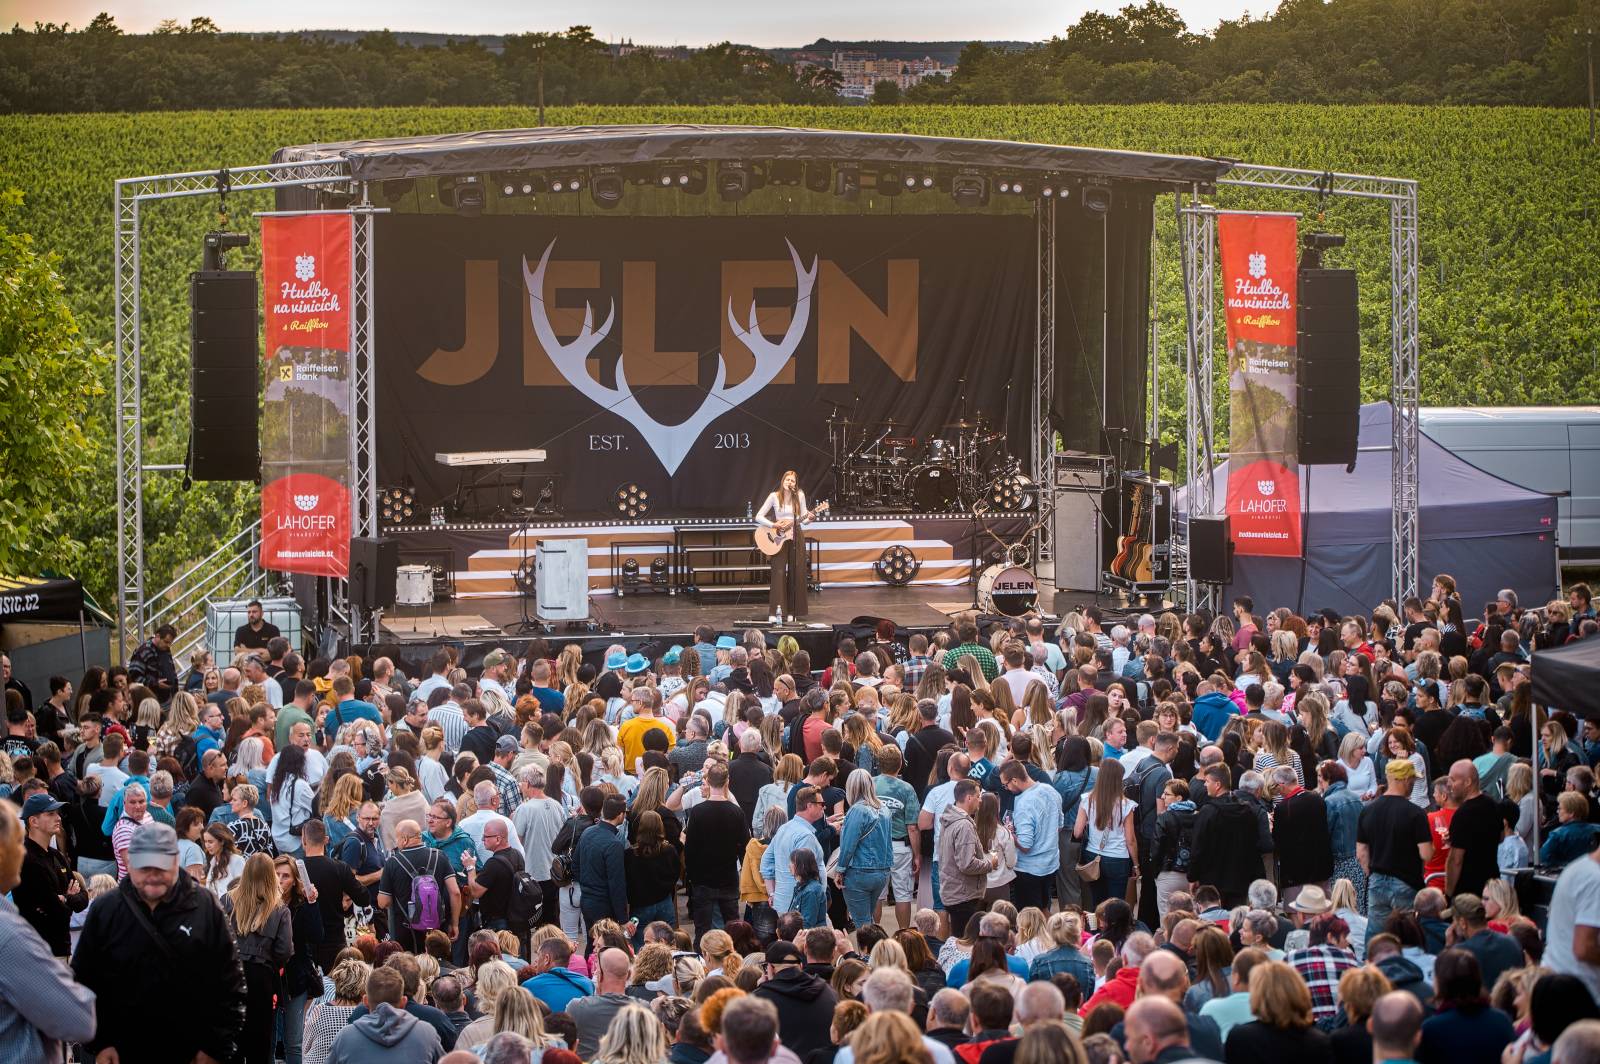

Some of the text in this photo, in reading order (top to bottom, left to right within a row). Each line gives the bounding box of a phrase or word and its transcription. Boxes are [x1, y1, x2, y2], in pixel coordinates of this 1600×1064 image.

[281, 281, 331, 299] Hudba
[1235, 278, 1282, 295] Hudba
[273, 303, 290, 314] na
[1228, 298, 1244, 308] na
[415, 258, 919, 386] JELEN
[296, 363, 339, 373] Raiffeisen
[1248, 358, 1289, 368] Raiffeisen
[1248, 366, 1270, 374] Bank
[296, 373, 318, 381] Bank
[589, 433, 751, 451] EST. 2013
[1240, 499, 1286, 512] LAHOFER
[277, 515, 335, 529] LAHOFER
[994, 582, 1034, 591] JELEN
